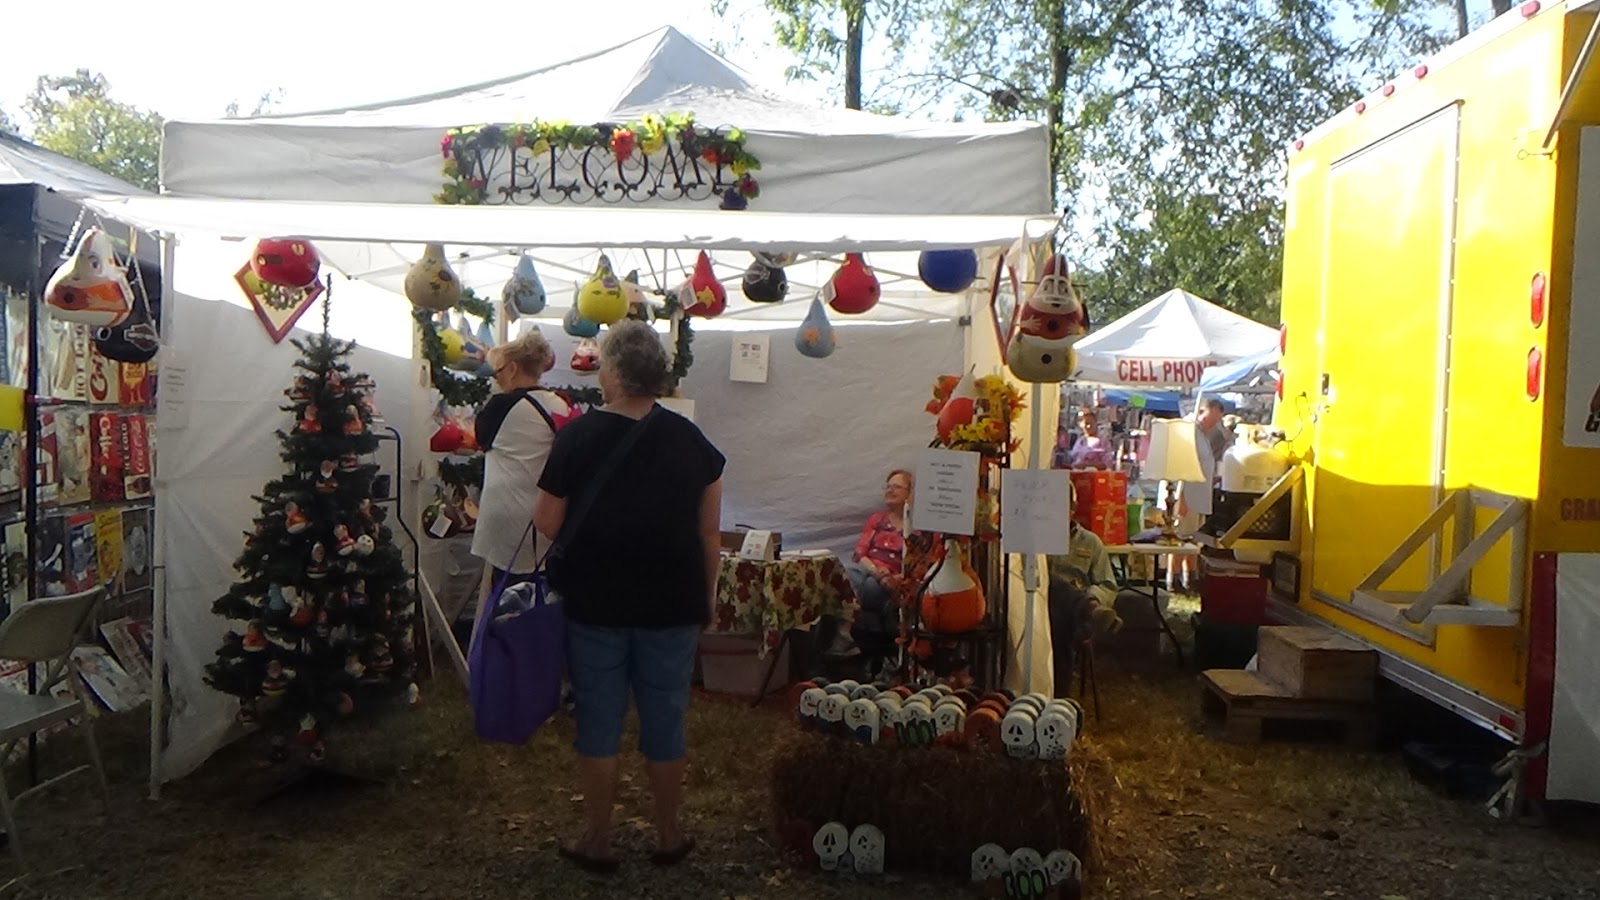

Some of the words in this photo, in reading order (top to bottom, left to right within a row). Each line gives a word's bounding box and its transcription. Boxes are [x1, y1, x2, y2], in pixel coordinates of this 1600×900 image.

[89, 341, 108, 402] Coff
[1118, 359, 1157, 382] CELL
[1163, 359, 1217, 383] PHON
[1561, 499, 1600, 521] GRA
